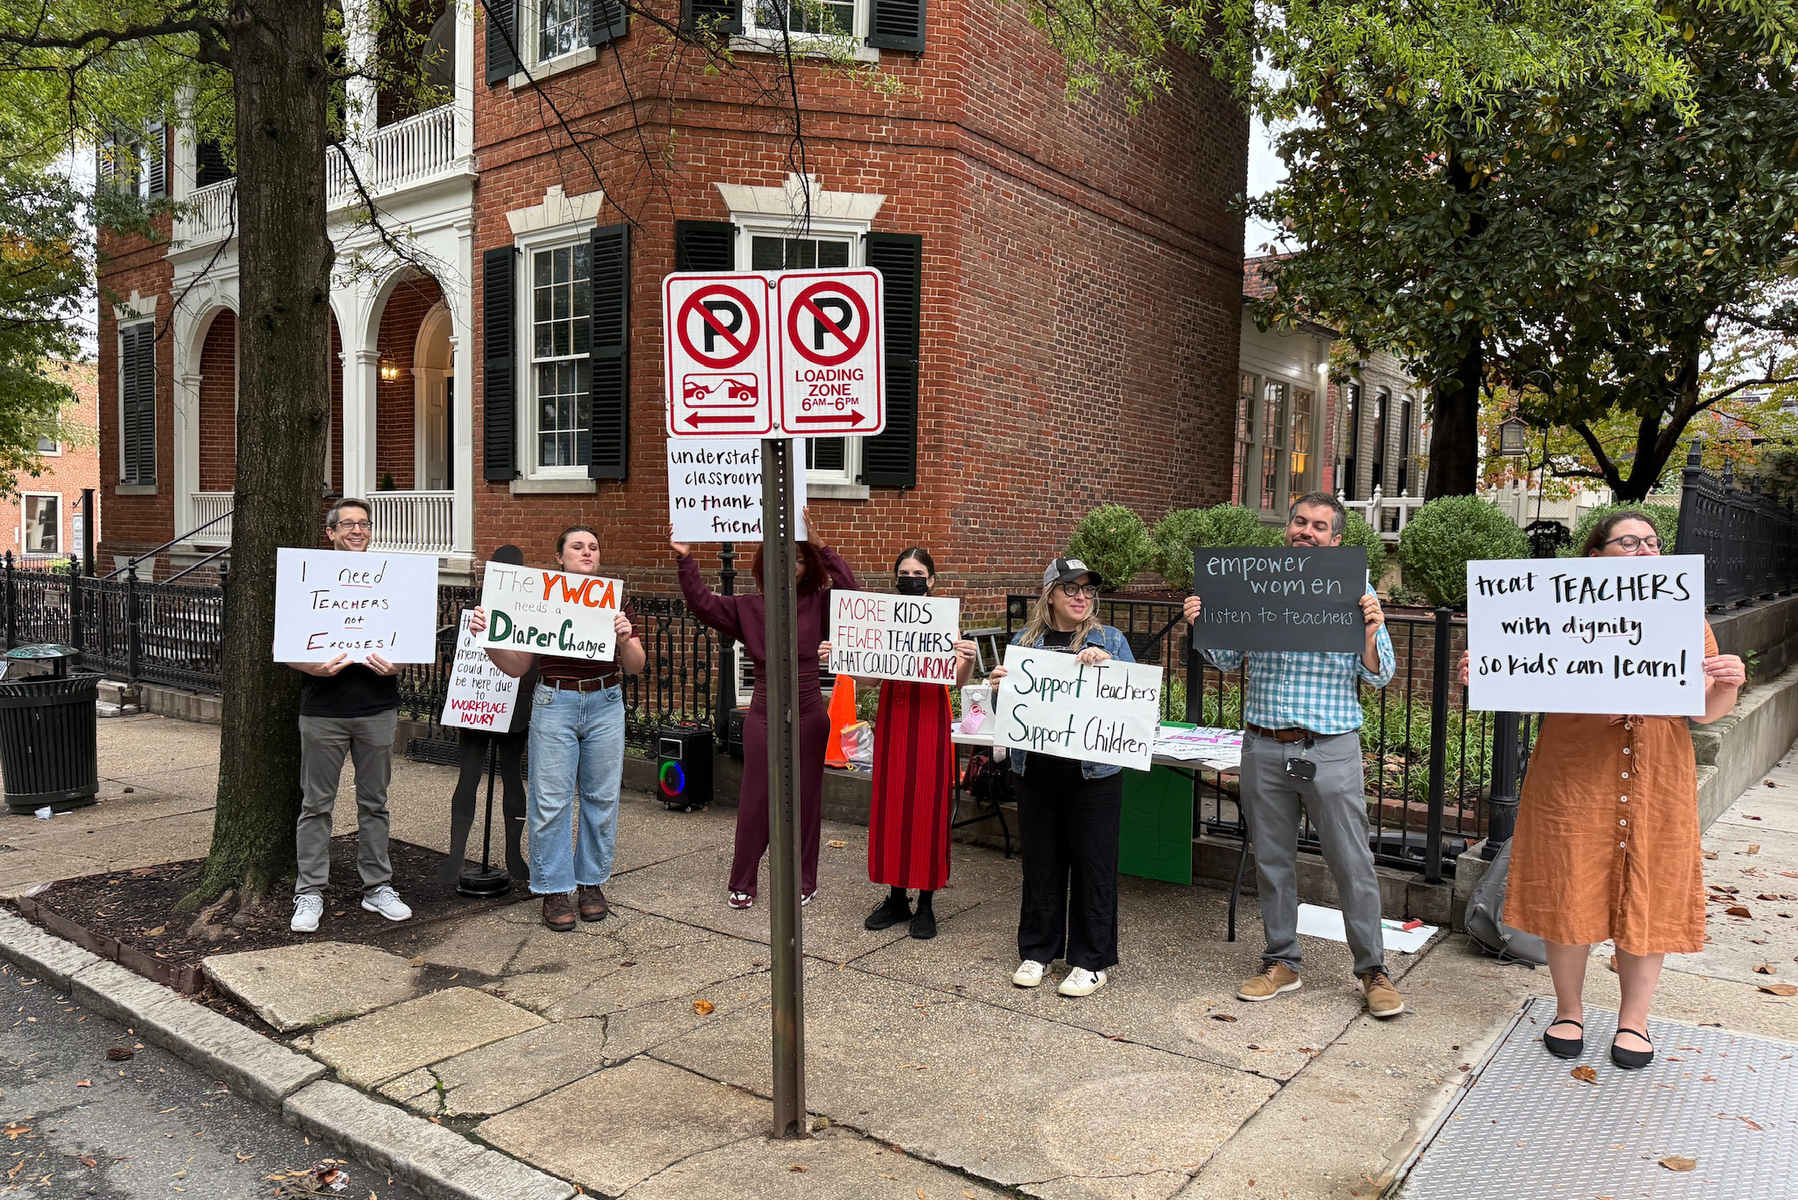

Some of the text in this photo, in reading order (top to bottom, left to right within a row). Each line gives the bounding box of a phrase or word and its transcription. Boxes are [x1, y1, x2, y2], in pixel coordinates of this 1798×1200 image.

[796, 368, 864, 382] LOADING
[808, 384, 852, 396] ZONE
[671, 448, 762, 464] understaf
[676, 496, 696, 509] no
[701, 495, 754, 511] thank
[302, 560, 387, 584] I need
[1206, 556, 1312, 581] empower
[493, 569, 616, 609] The YWCA
[1250, 577, 1342, 596] women
[1475, 571, 1690, 605] treat TEACHERS
[310, 589, 389, 610] TEACHERS
[514, 600, 548, 614] needs
[344, 616, 365, 625] not
[838, 597, 933, 624] MORE KIDS
[1202, 607, 1353, 625] listen to teachers
[559, 619, 606, 658] Change
[837, 625, 954, 653] FEWER TEACHERS
[1501, 616, 1642, 645] with dignity
[457, 663, 482, 675] could
[830, 650, 957, 680] WHAT COULD GO WRONG?
[1508, 653, 1558, 676] kids
[1566, 658, 1604, 675] can
[1614, 649, 1688, 686] learn!
[455, 677, 513, 693] be here due
[1014, 659, 1157, 702] Support Teachers
[475, 691, 486, 701] to
[451, 699, 508, 714] WORKPLACE
[460, 711, 495, 726] INJURY
[1008, 703, 1076, 751] Support
[1084, 716, 1147, 757] Children
